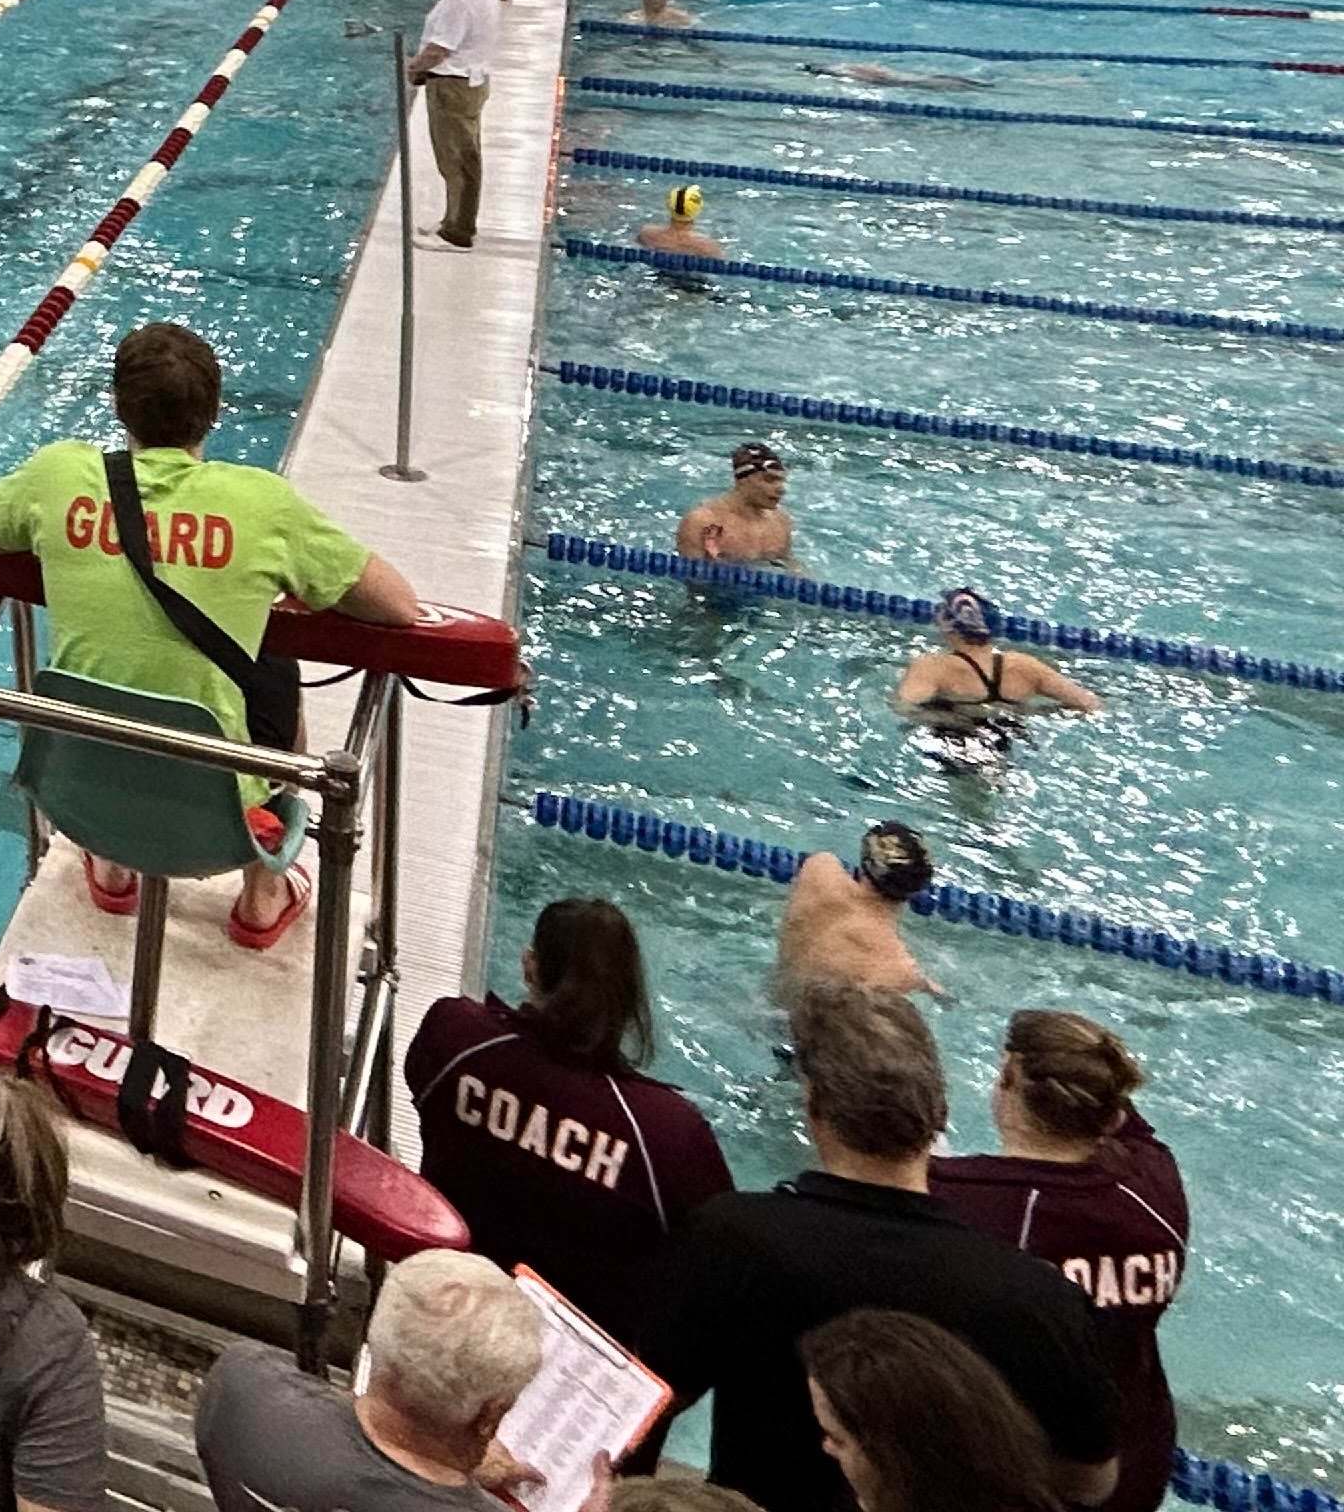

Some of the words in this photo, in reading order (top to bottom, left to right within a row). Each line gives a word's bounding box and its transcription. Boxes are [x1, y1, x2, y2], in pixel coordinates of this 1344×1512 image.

[46, 1026, 255, 1129] GURD
[455, 1073, 629, 1190] COACH
[1062, 1249, 1178, 1308] OACH
